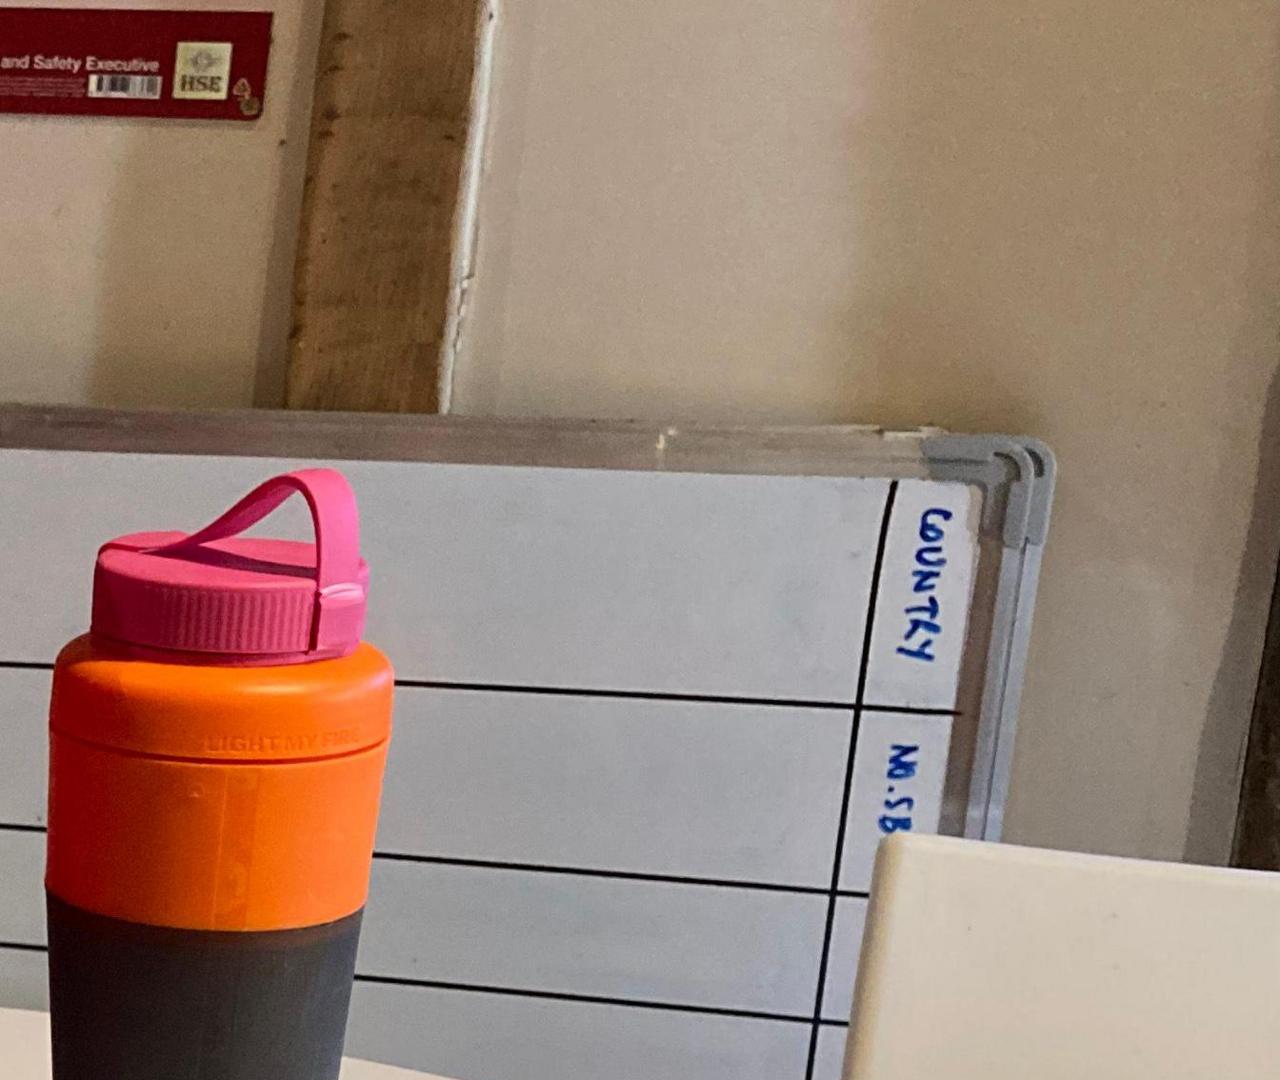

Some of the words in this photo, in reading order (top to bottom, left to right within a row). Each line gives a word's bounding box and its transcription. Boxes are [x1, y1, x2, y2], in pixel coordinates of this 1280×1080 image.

[1, 56, 29, 69] and
[34, 56, 81, 73] Safety
[86, 57, 160, 72] Executive
[180, 75, 223, 92] HSE
[896, 508, 953, 662] COUNTRY
